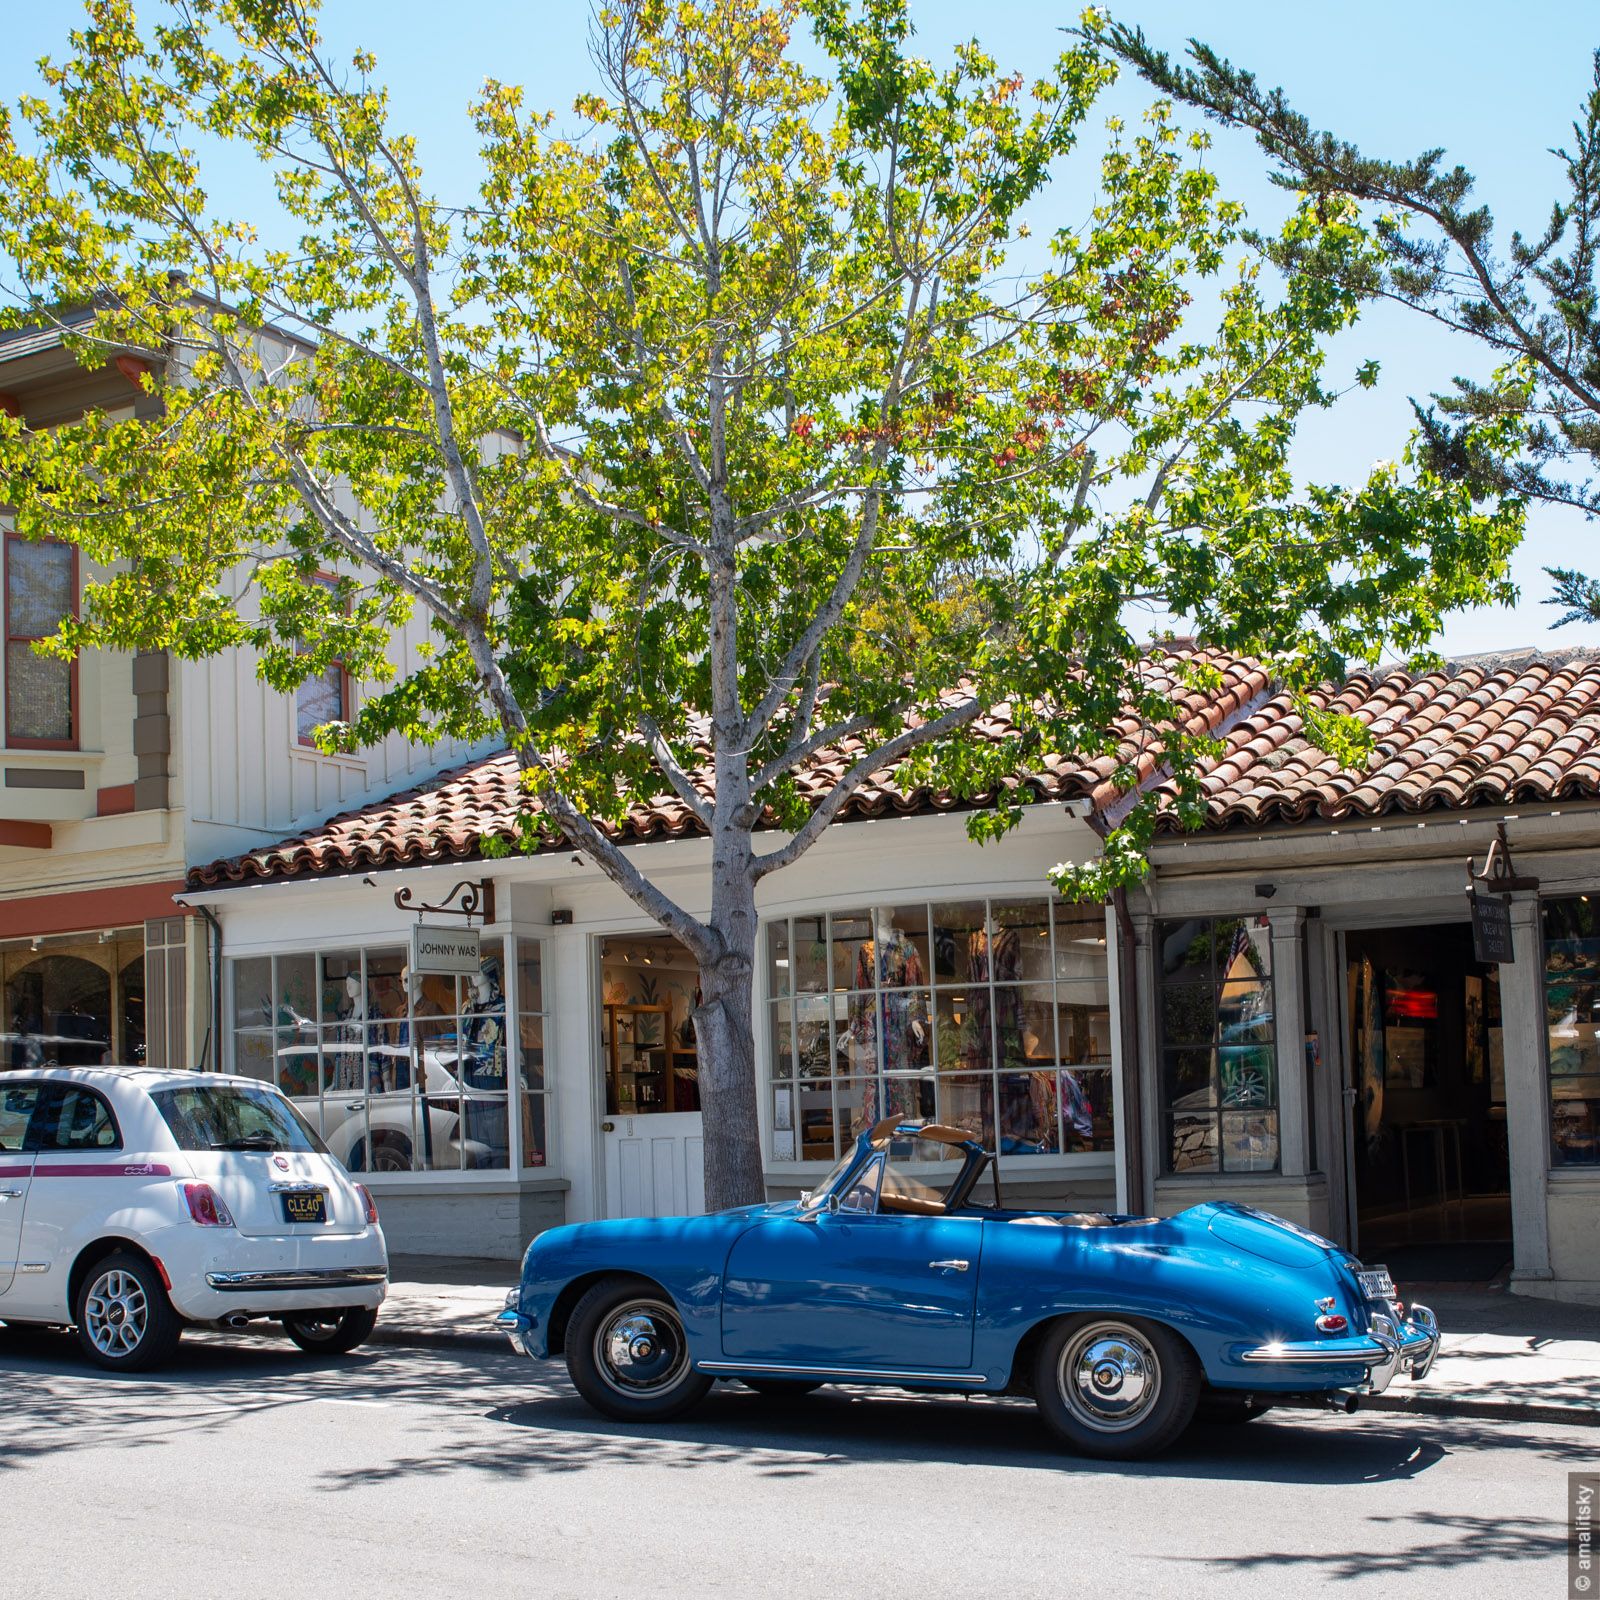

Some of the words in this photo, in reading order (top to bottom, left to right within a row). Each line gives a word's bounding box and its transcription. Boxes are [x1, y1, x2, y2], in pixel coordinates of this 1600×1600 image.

[420, 943, 455, 955] JOHNNY
[457, 945, 477, 957] WAS
[287, 1199, 320, 1212] CLE40
